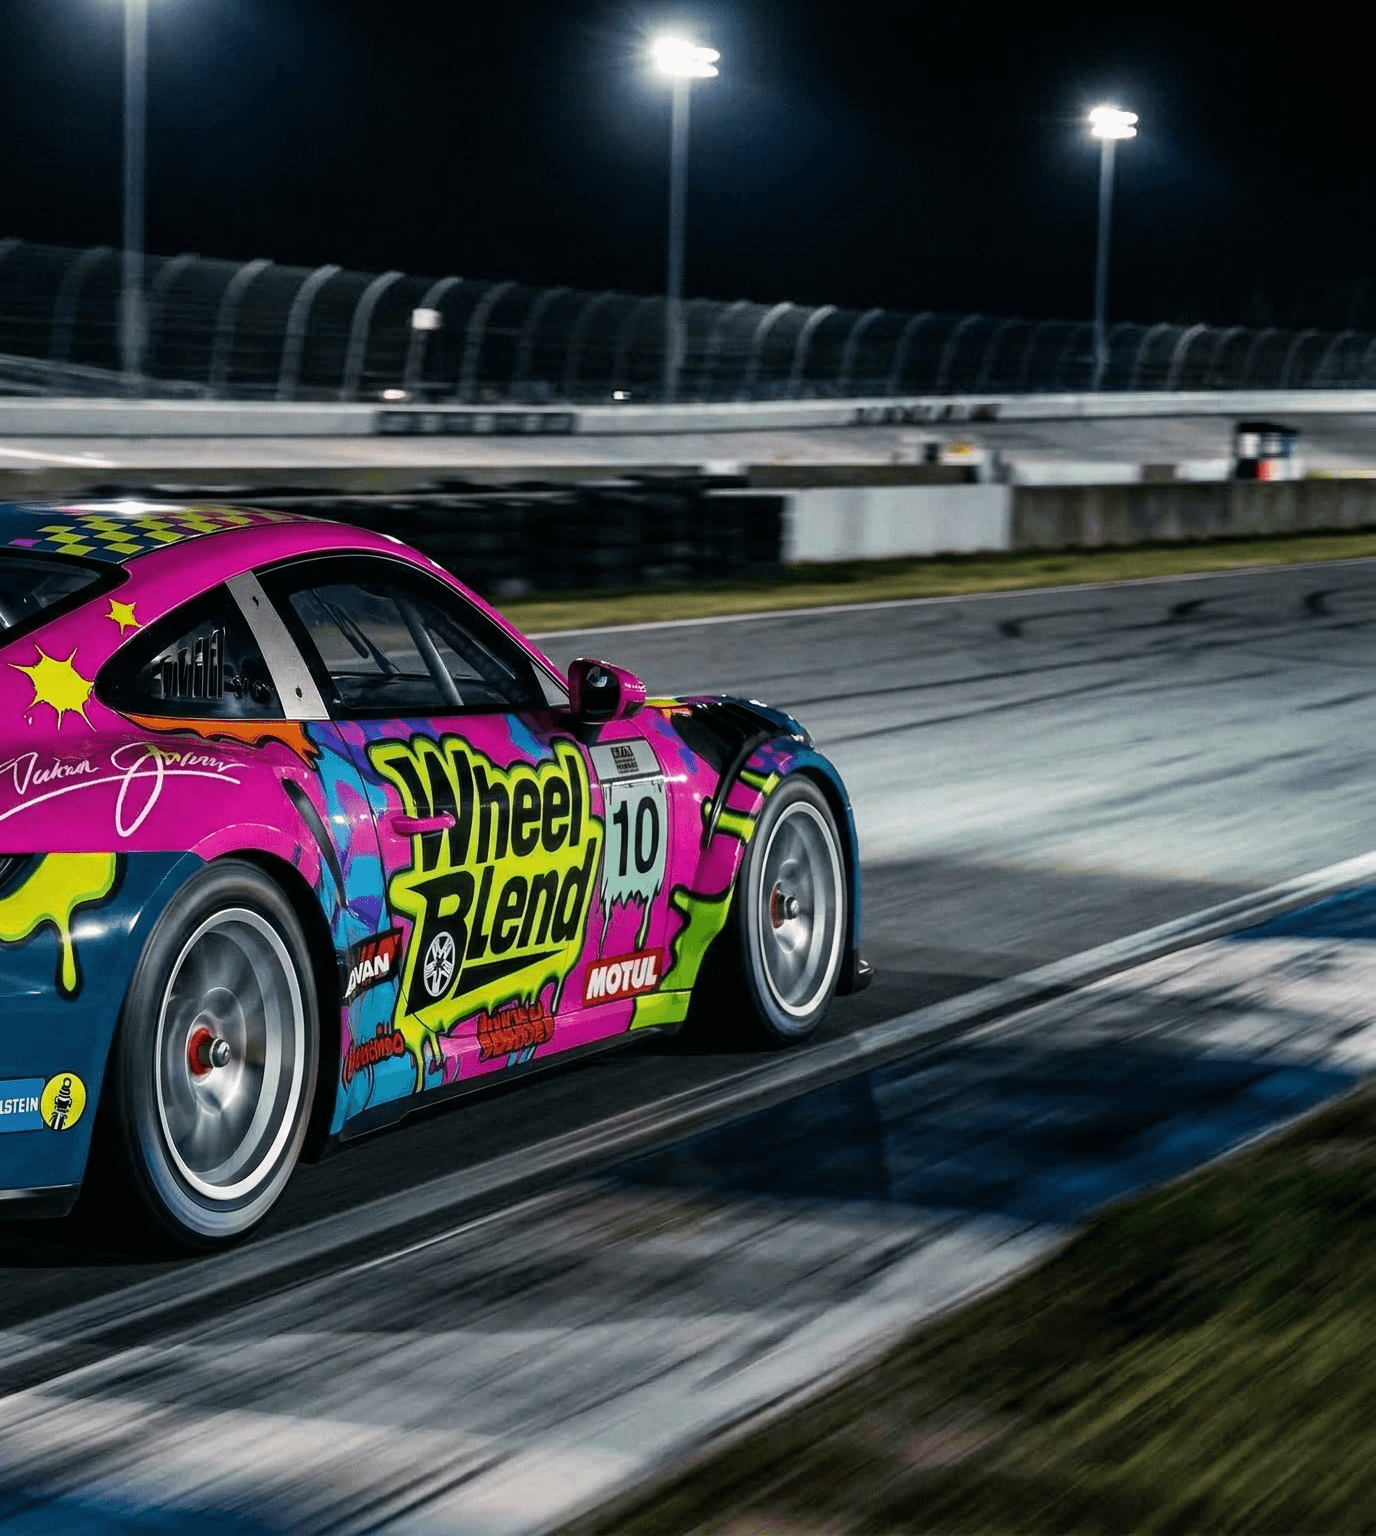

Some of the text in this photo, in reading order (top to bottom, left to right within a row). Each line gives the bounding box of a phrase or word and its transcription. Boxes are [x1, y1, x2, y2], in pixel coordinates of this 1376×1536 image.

[383, 749, 583, 873] Wheel
[612, 796, 660, 877] 10
[586, 955, 658, 1000] MOTUL
